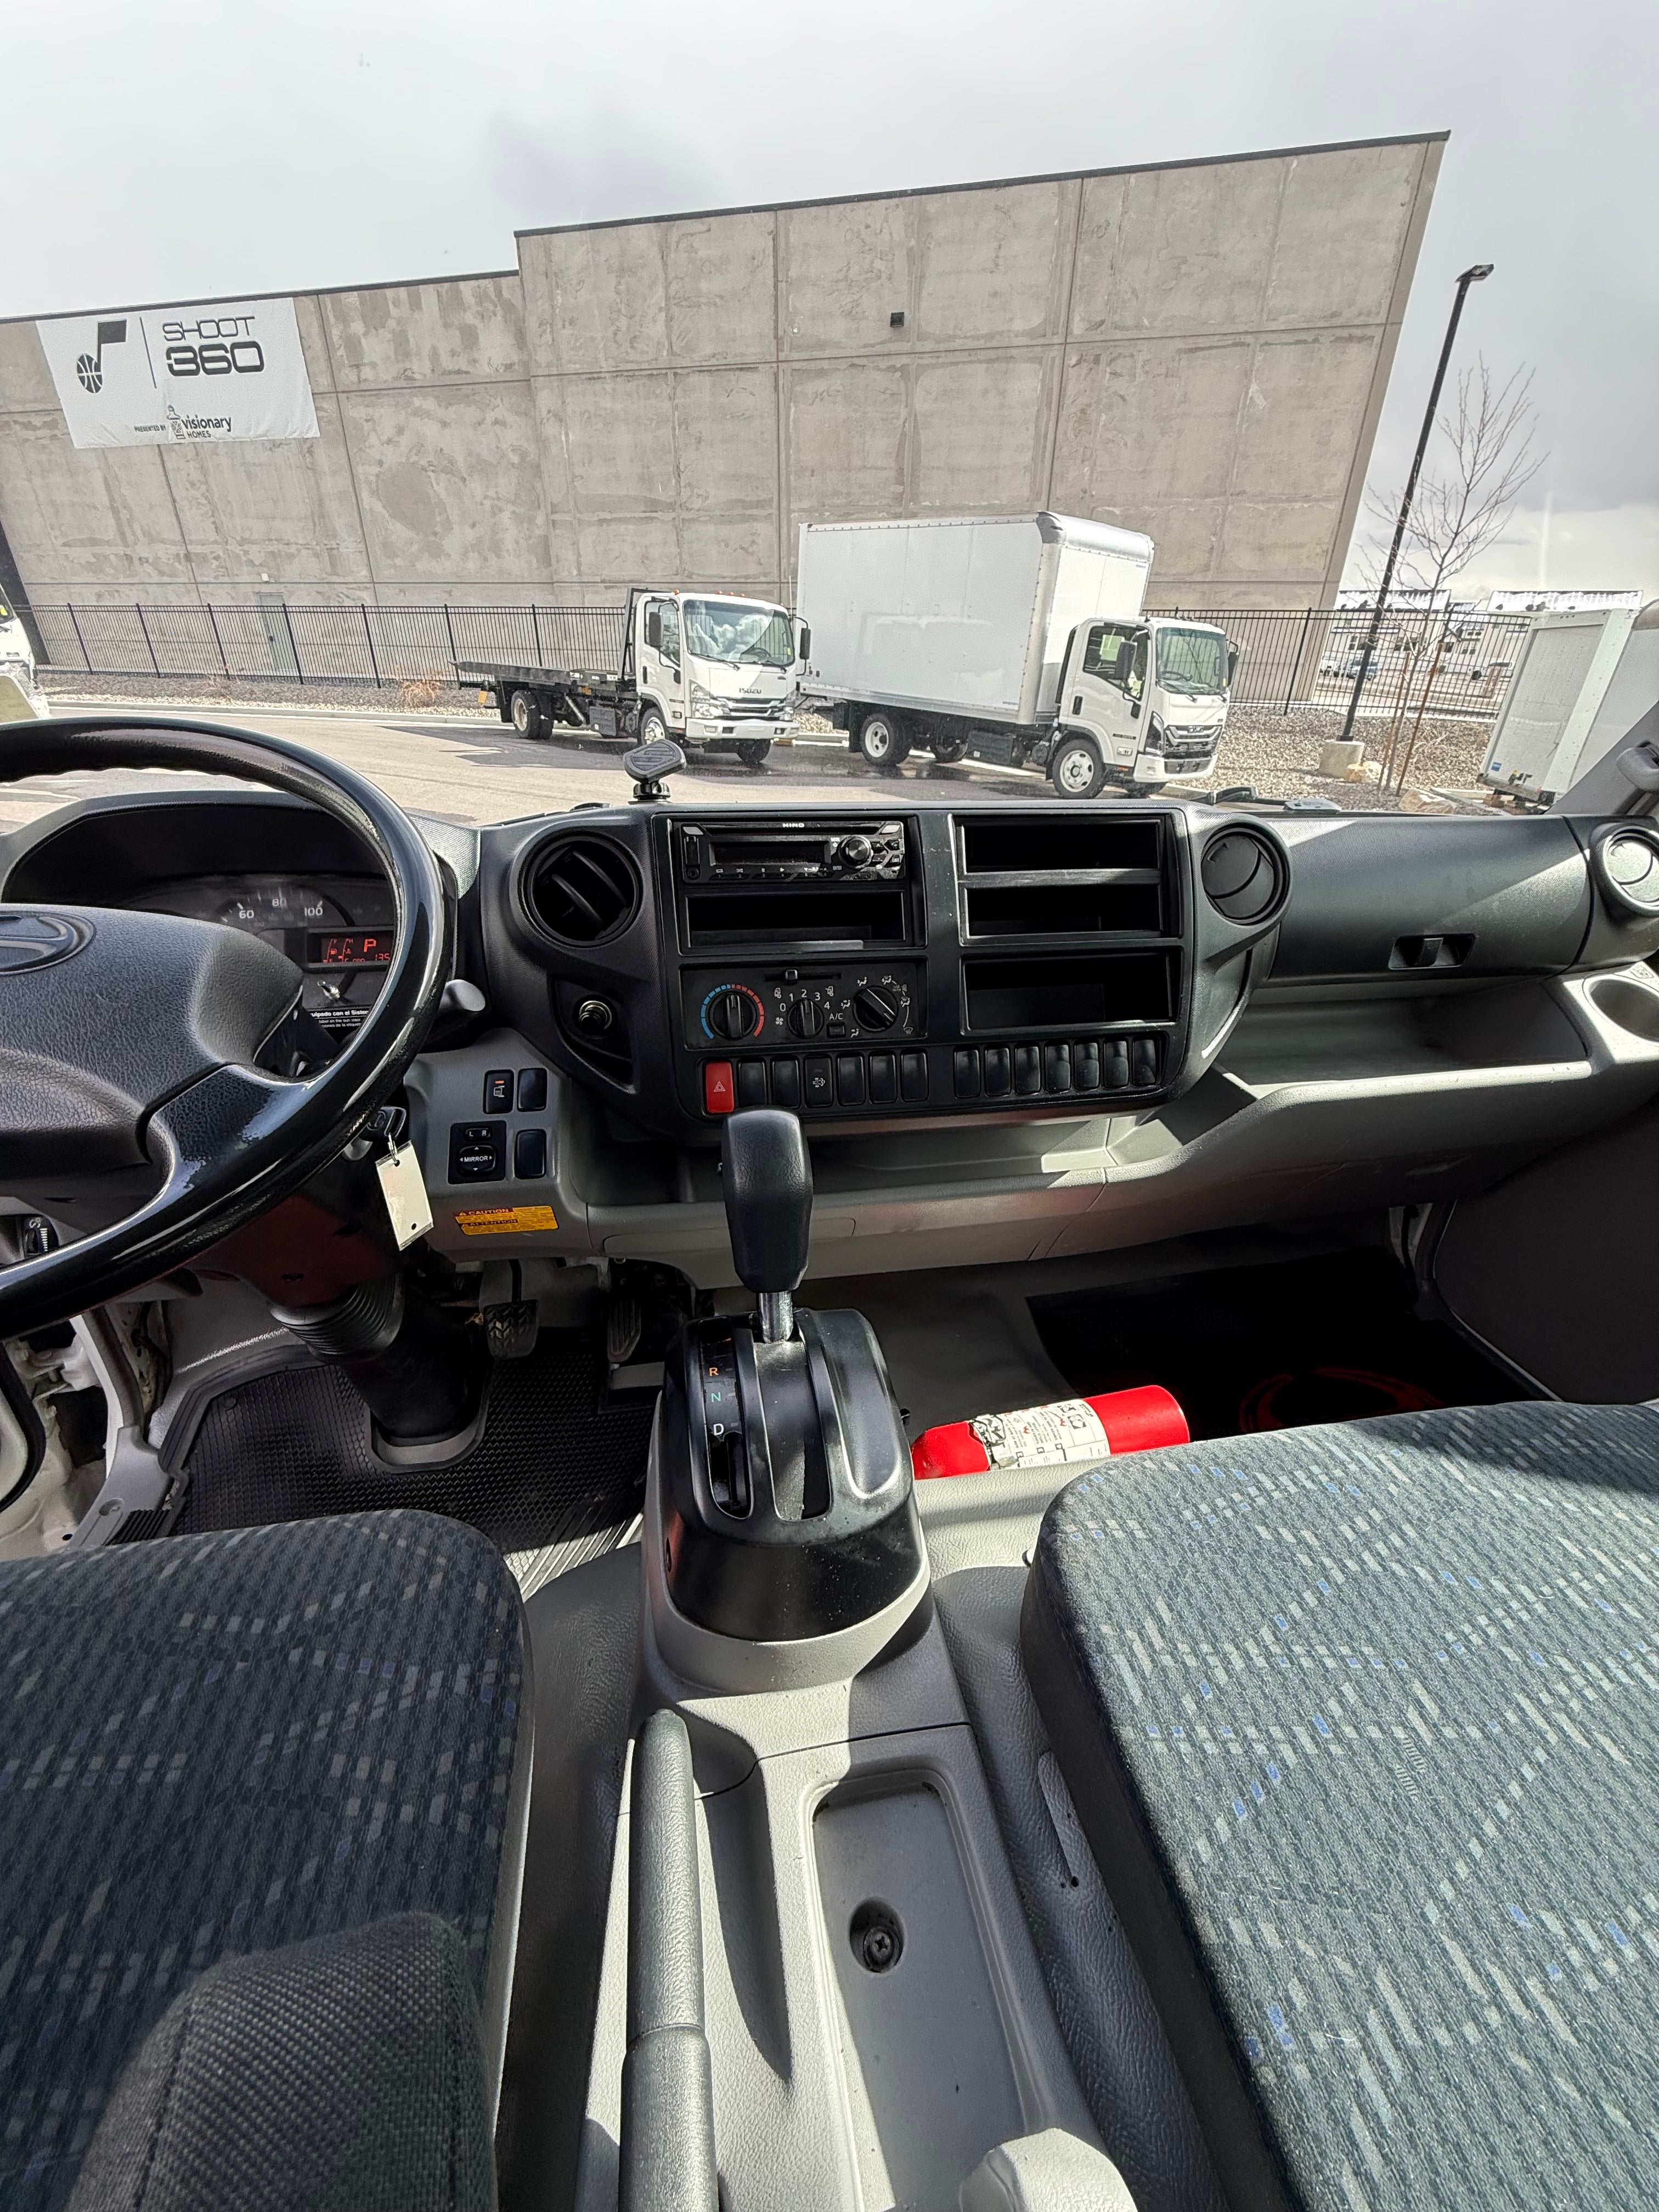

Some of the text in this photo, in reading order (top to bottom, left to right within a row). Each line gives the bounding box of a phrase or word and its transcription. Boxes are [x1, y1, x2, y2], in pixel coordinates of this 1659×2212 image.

[162, 315, 255, 341] SHOOT
[166, 341, 264, 376] 360
[181, 414, 232, 432] visionary
[134, 425, 160, 433] PRESENTED
[187, 430, 211, 438] HOMES
[272, 898, 287, 908] 80
[239, 910, 255, 919] 60
[304, 906, 323, 916] 100
[364, 939, 376, 952] P
[789, 994, 793, 1002] 1
[802, 989, 808, 998] 2
[815, 992, 821, 1001] 3
[780, 1003, 786, 1012] 0
[824, 1001, 830, 1009] 4
[709, 1367, 719, 1376] R
[711, 1392, 721, 1402] N
[714, 1424, 724, 1436] D
